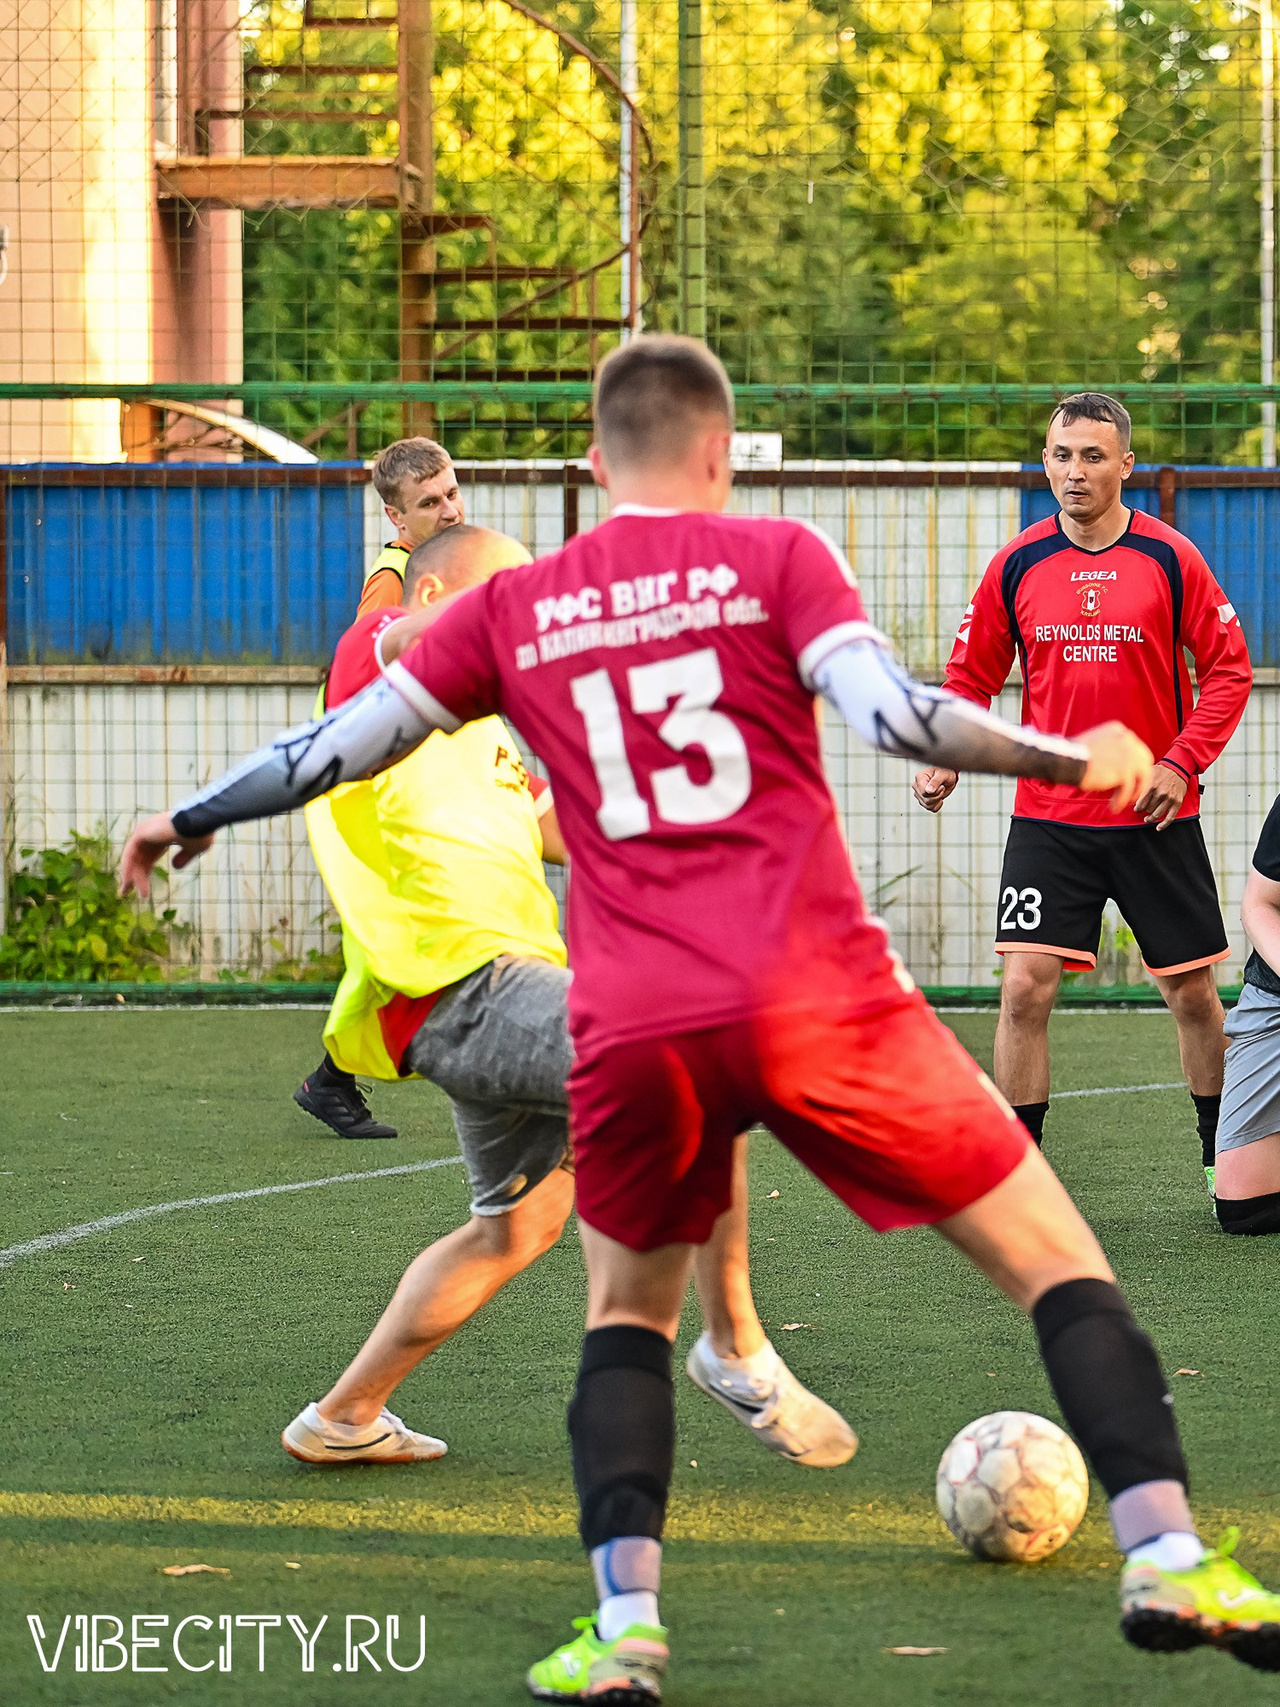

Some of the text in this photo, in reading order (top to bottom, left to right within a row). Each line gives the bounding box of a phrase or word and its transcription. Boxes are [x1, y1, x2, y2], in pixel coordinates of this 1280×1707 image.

[1070, 570, 1117, 582] LEGEA
[533, 563, 738, 632] УФС ВНГ РФ
[1035, 624, 1144, 642] REYNOLDS METAL
[1063, 645, 1118, 662] CENTRE
[569, 647, 752, 841] 13
[1001, 886, 1042, 931] 23
